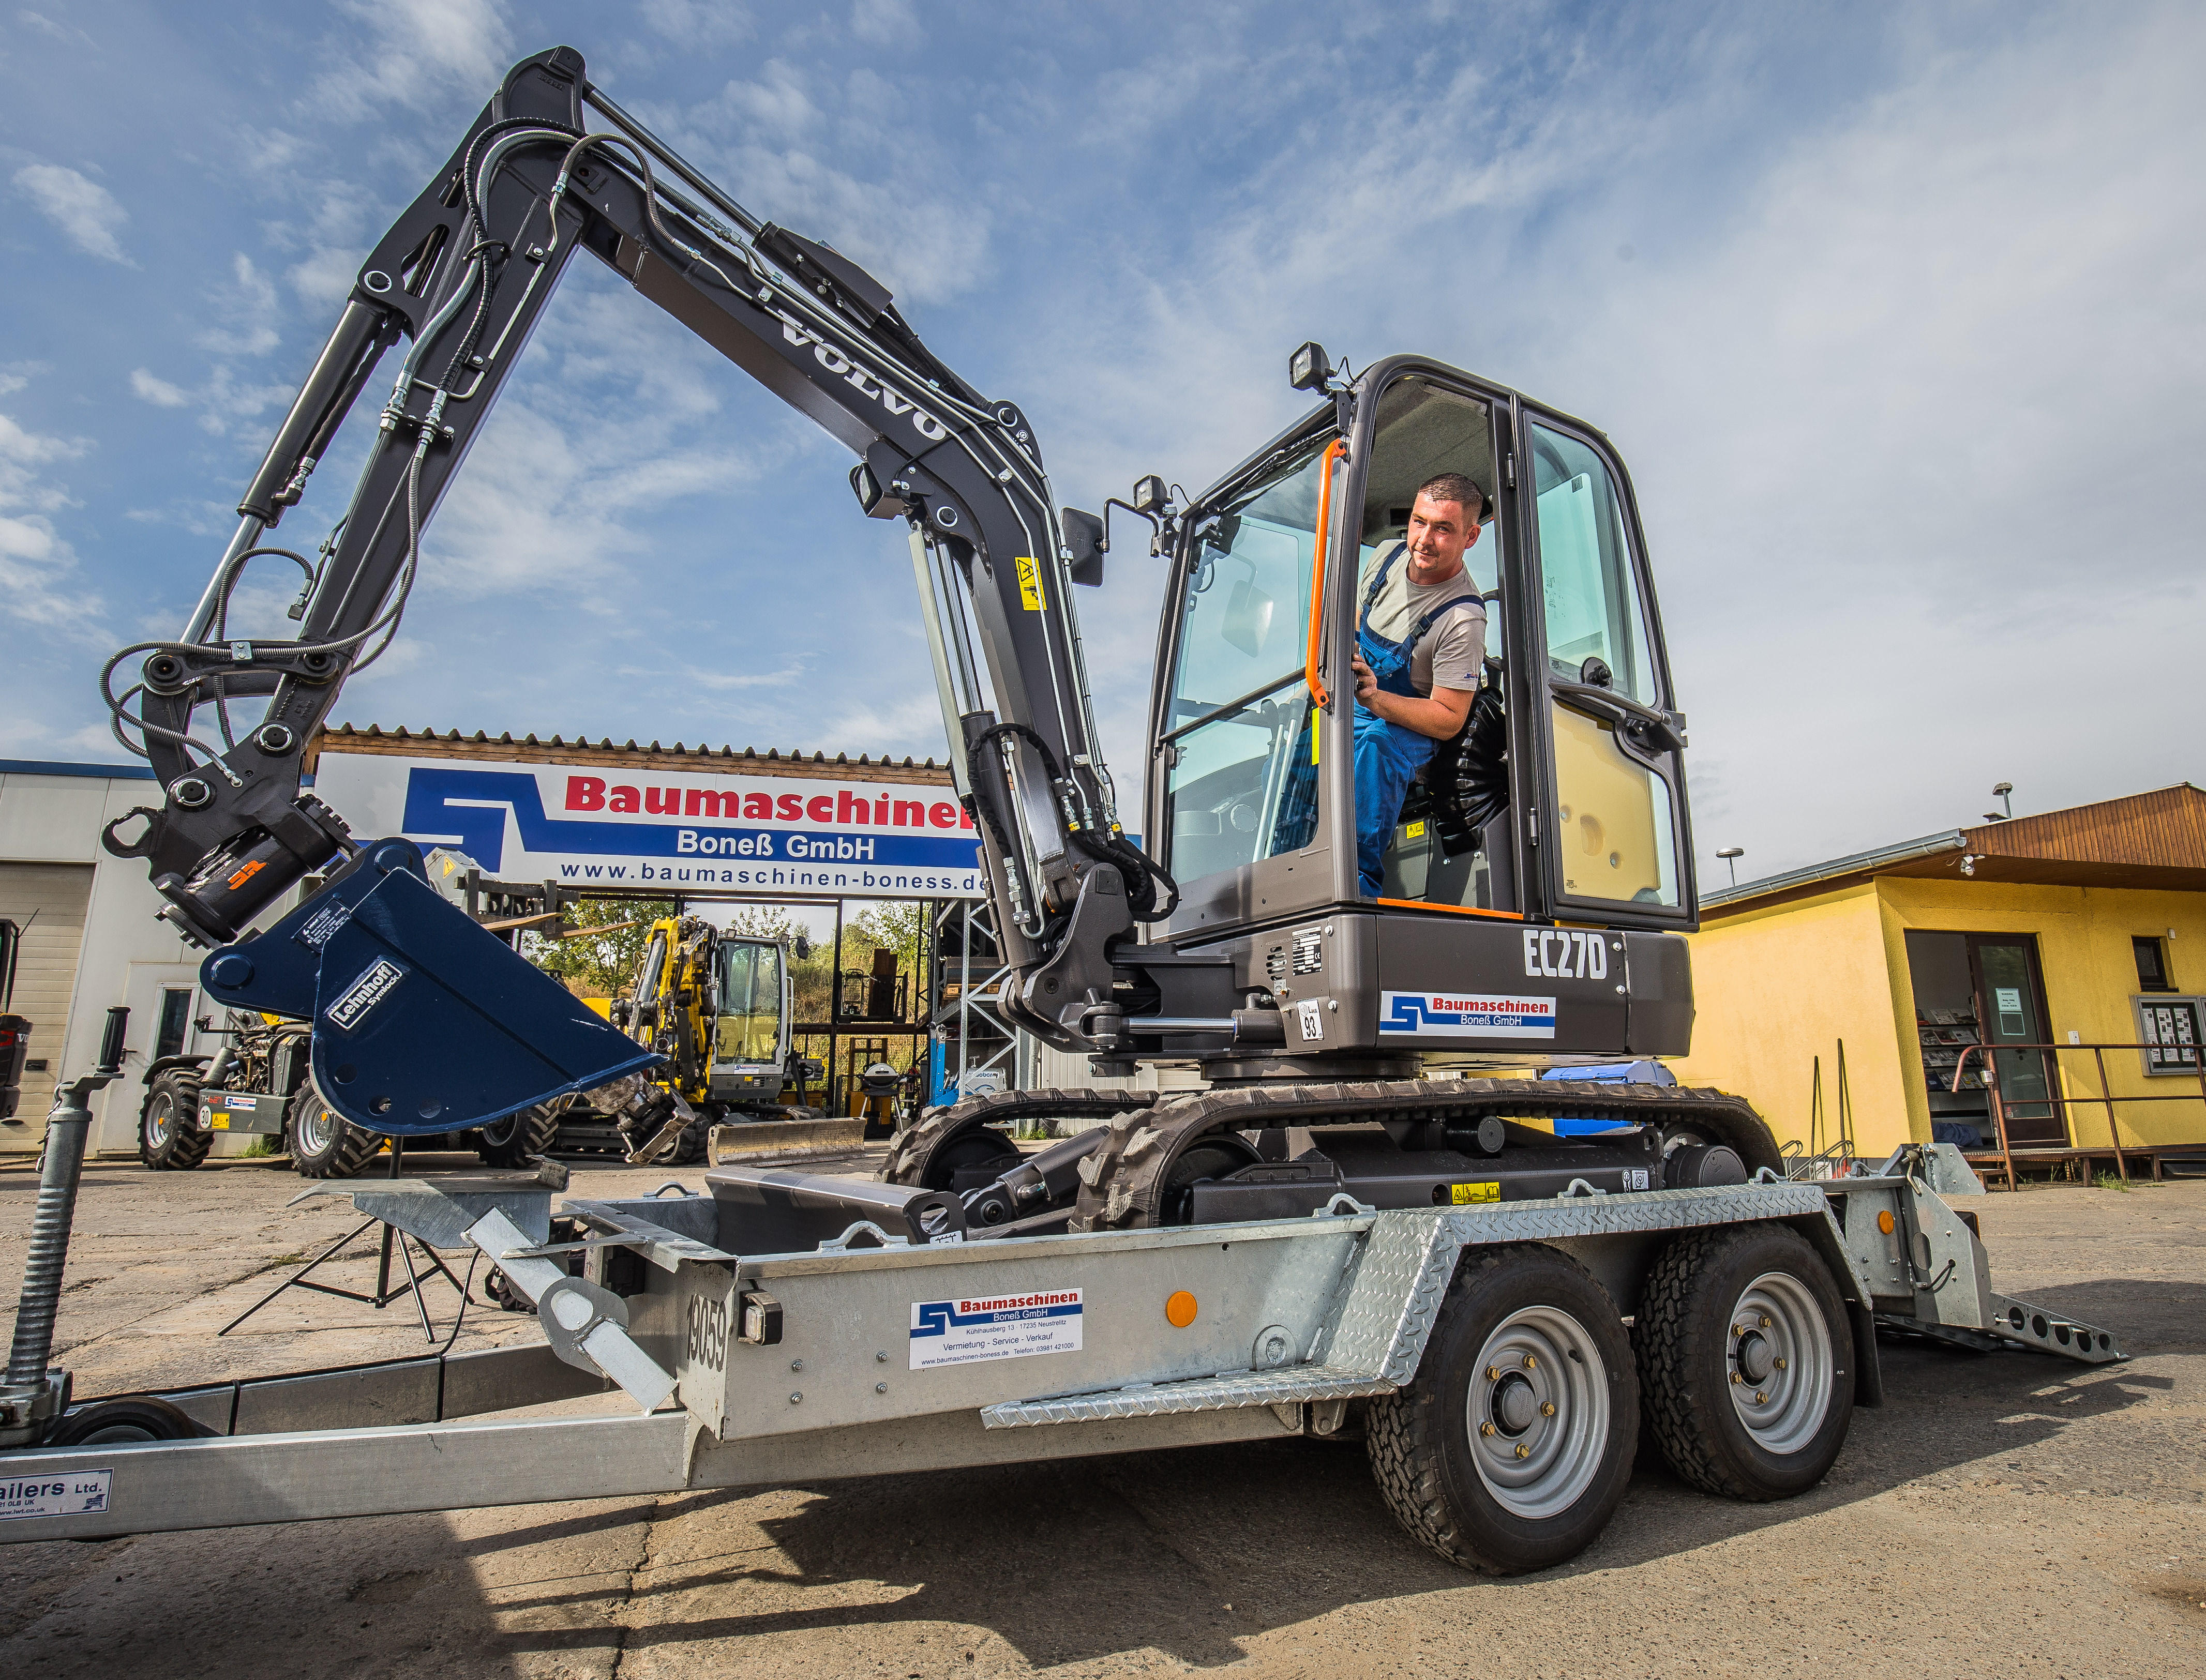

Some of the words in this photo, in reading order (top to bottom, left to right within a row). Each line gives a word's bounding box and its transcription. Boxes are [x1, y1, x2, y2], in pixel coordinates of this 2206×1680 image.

[778, 309, 946, 441] VOLVO
[677, 829, 773, 856] Boneß
[786, 835, 874, 860] GmbH
[1523, 930, 1607, 979] EC27D
[334, 964, 393, 1022] Lehnhoff
[367, 974, 400, 1006] Symlock
[1432, 997, 1549, 1013] Baumaschinen
[1304, 1016, 1316, 1038] 93
[1461, 1015, 1491, 1025] Boneß
[1493, 1016, 1522, 1026] GmbH
[201, 1110, 209, 1124] 30
[961, 1292, 1078, 1313] Baumaschinen
[994, 1312, 1020, 1322] Boneß
[1022, 1308, 1048, 1319] GmbH
[687, 1294, 727, 1372] 19059
[966, 1326, 1006, 1335] Kühlhausberg
[1038, 1320, 1067, 1328] Neustrelitz
[943, 1341, 985, 1351] Vermietung
[993, 1337, 1019, 1346] Service
[1026, 1332, 1053, 1342] Verkauf
[921, 1351, 1009, 1365] www.baumaschinen-boness.de
[1014, 1347, 1035, 1355] Telefon:
[75, 1482, 102, 1494] Ltd.
